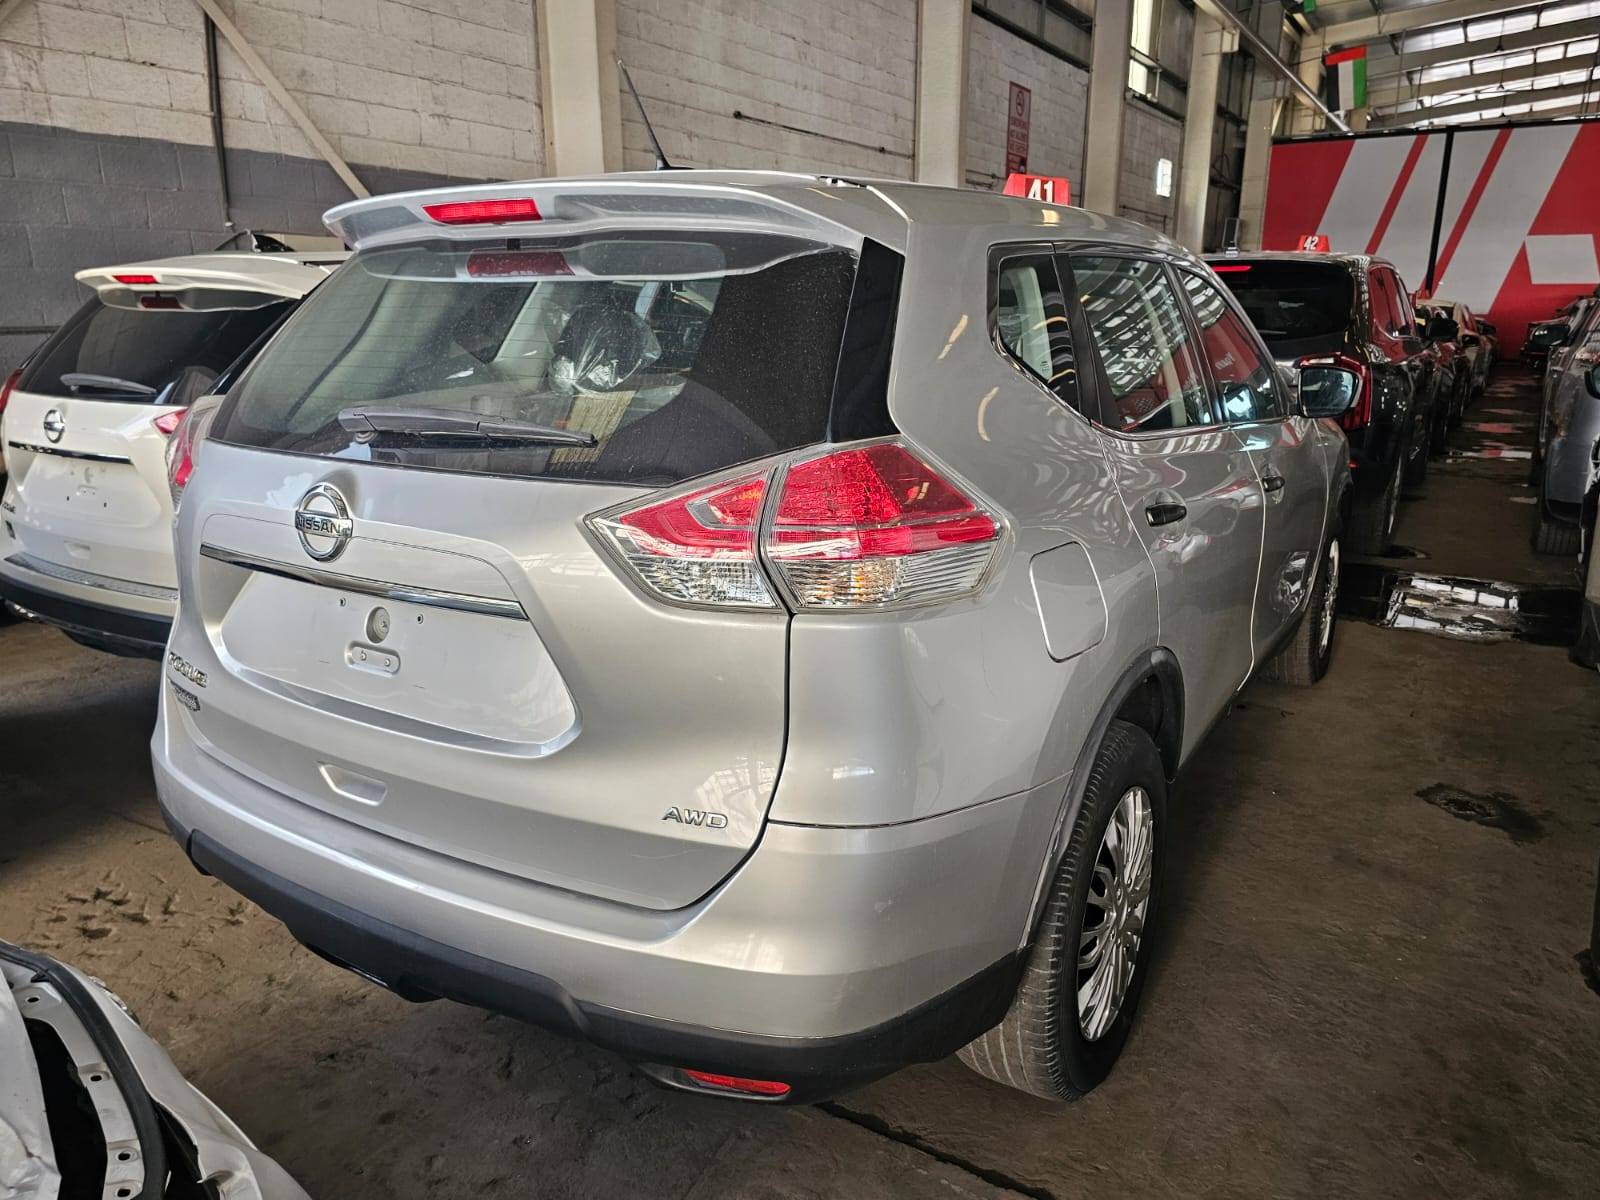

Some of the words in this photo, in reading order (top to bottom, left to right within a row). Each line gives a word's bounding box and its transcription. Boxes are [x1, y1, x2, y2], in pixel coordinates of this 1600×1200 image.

[1027, 178, 1053, 203] 41
[1303, 235, 1319, 252] 42
[296, 514, 341, 534] NISSAN
[661, 806, 728, 829] AWD
